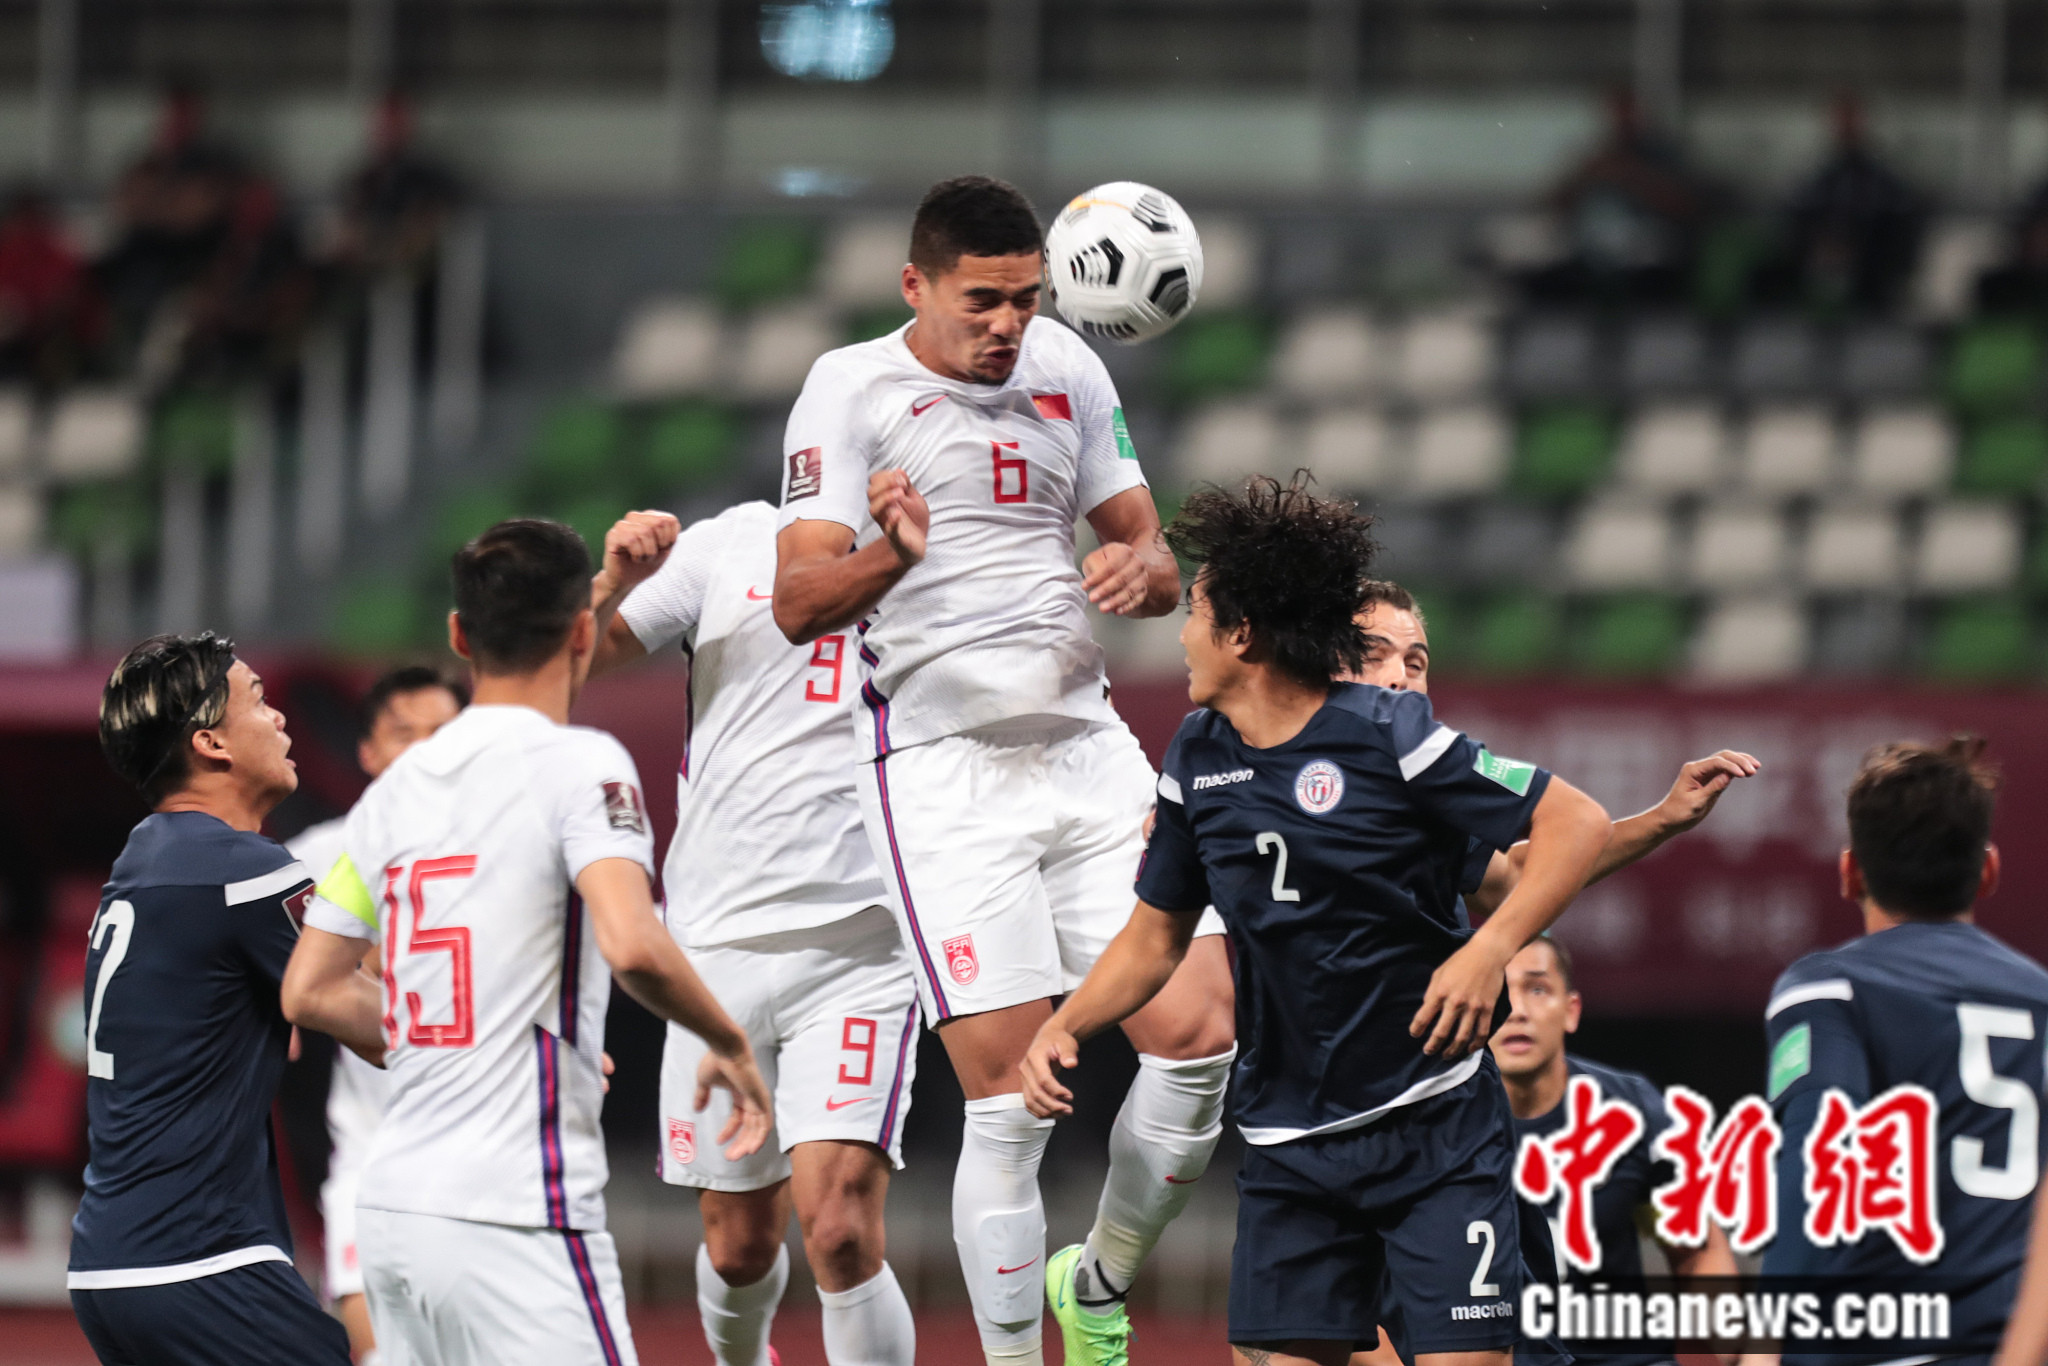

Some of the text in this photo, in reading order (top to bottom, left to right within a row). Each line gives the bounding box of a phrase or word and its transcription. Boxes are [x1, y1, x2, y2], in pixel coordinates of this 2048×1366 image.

[990, 440, 1028, 504] 6
[804, 634, 844, 703] 9
[1193, 768, 1254, 790] macron
[1256, 832, 1300, 902] 2
[382, 854, 478, 1050] 15
[87, 900, 135, 1081] 2
[838, 1016, 877, 1086] 9
[1951, 1002, 2039, 1201] 5
[1466, 1220, 1500, 1297] 2
[1451, 1301, 1513, 1320] macron
